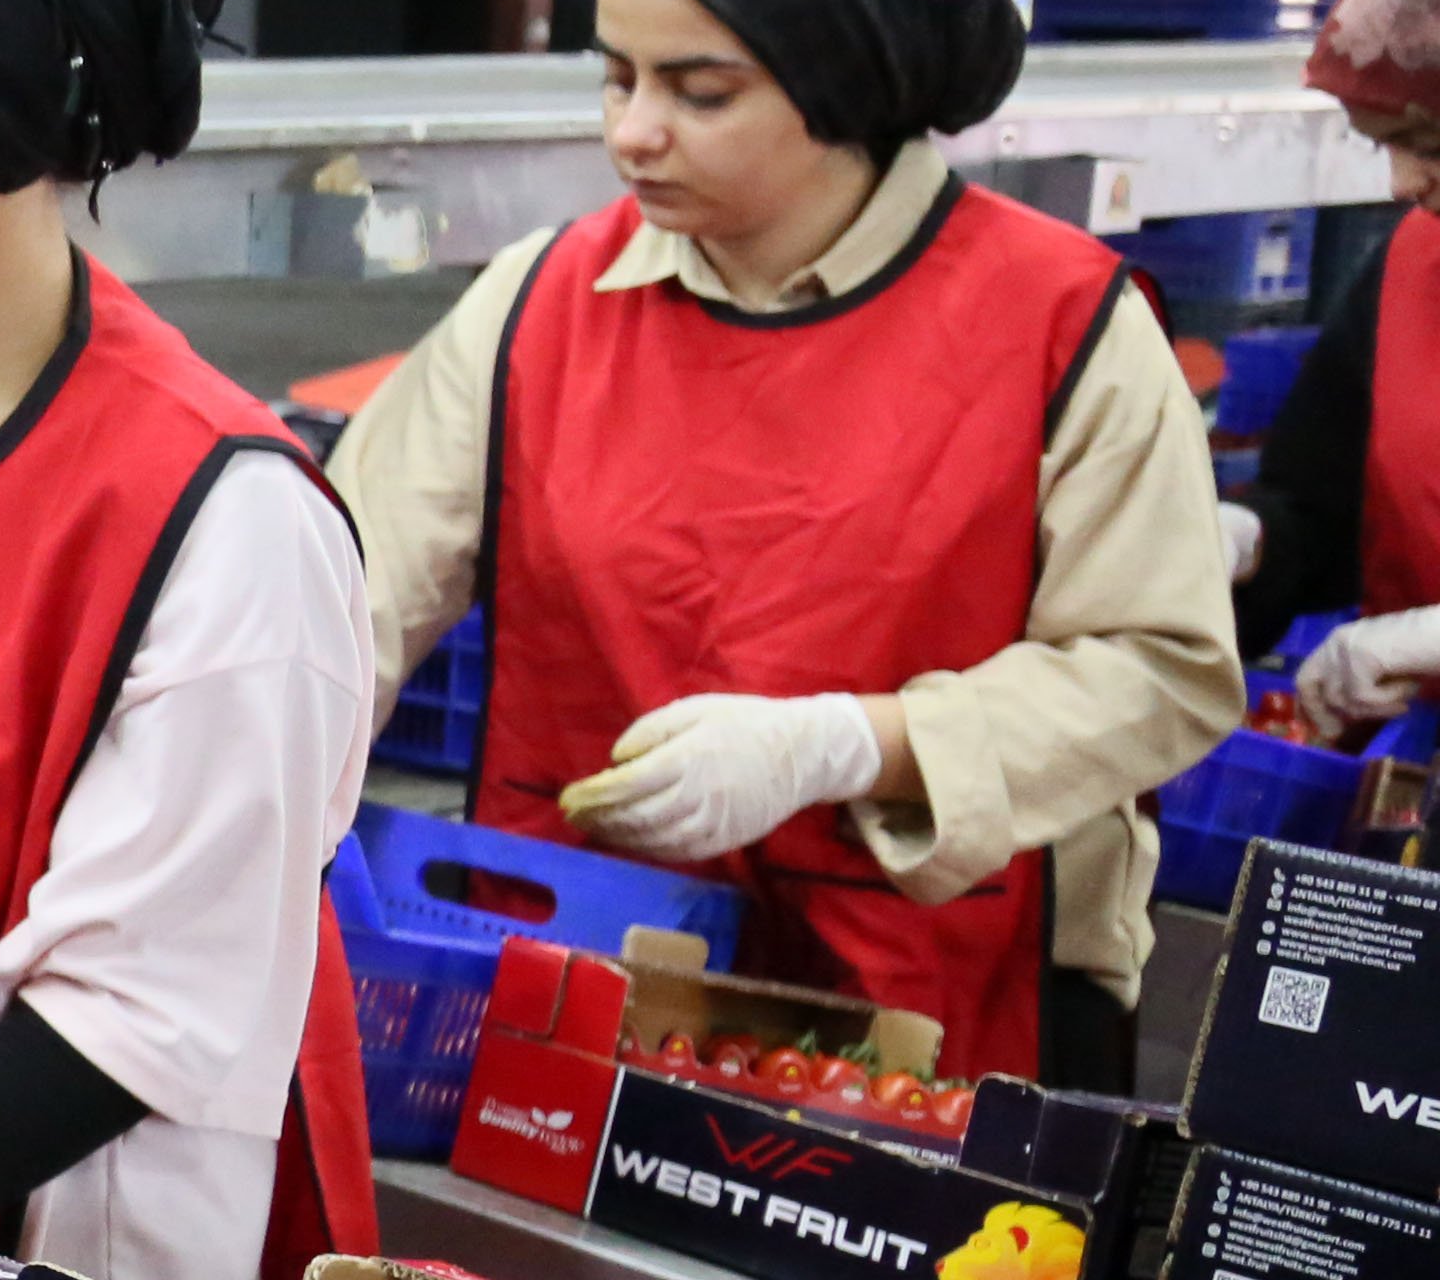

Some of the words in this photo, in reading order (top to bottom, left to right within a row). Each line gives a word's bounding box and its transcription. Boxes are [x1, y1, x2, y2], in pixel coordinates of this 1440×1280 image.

[1355, 1080, 1440, 1131] WE
[707, 1113, 854, 1184] WF
[612, 1141, 762, 1228] WEST
[761, 1199, 928, 1273] FRUIT
